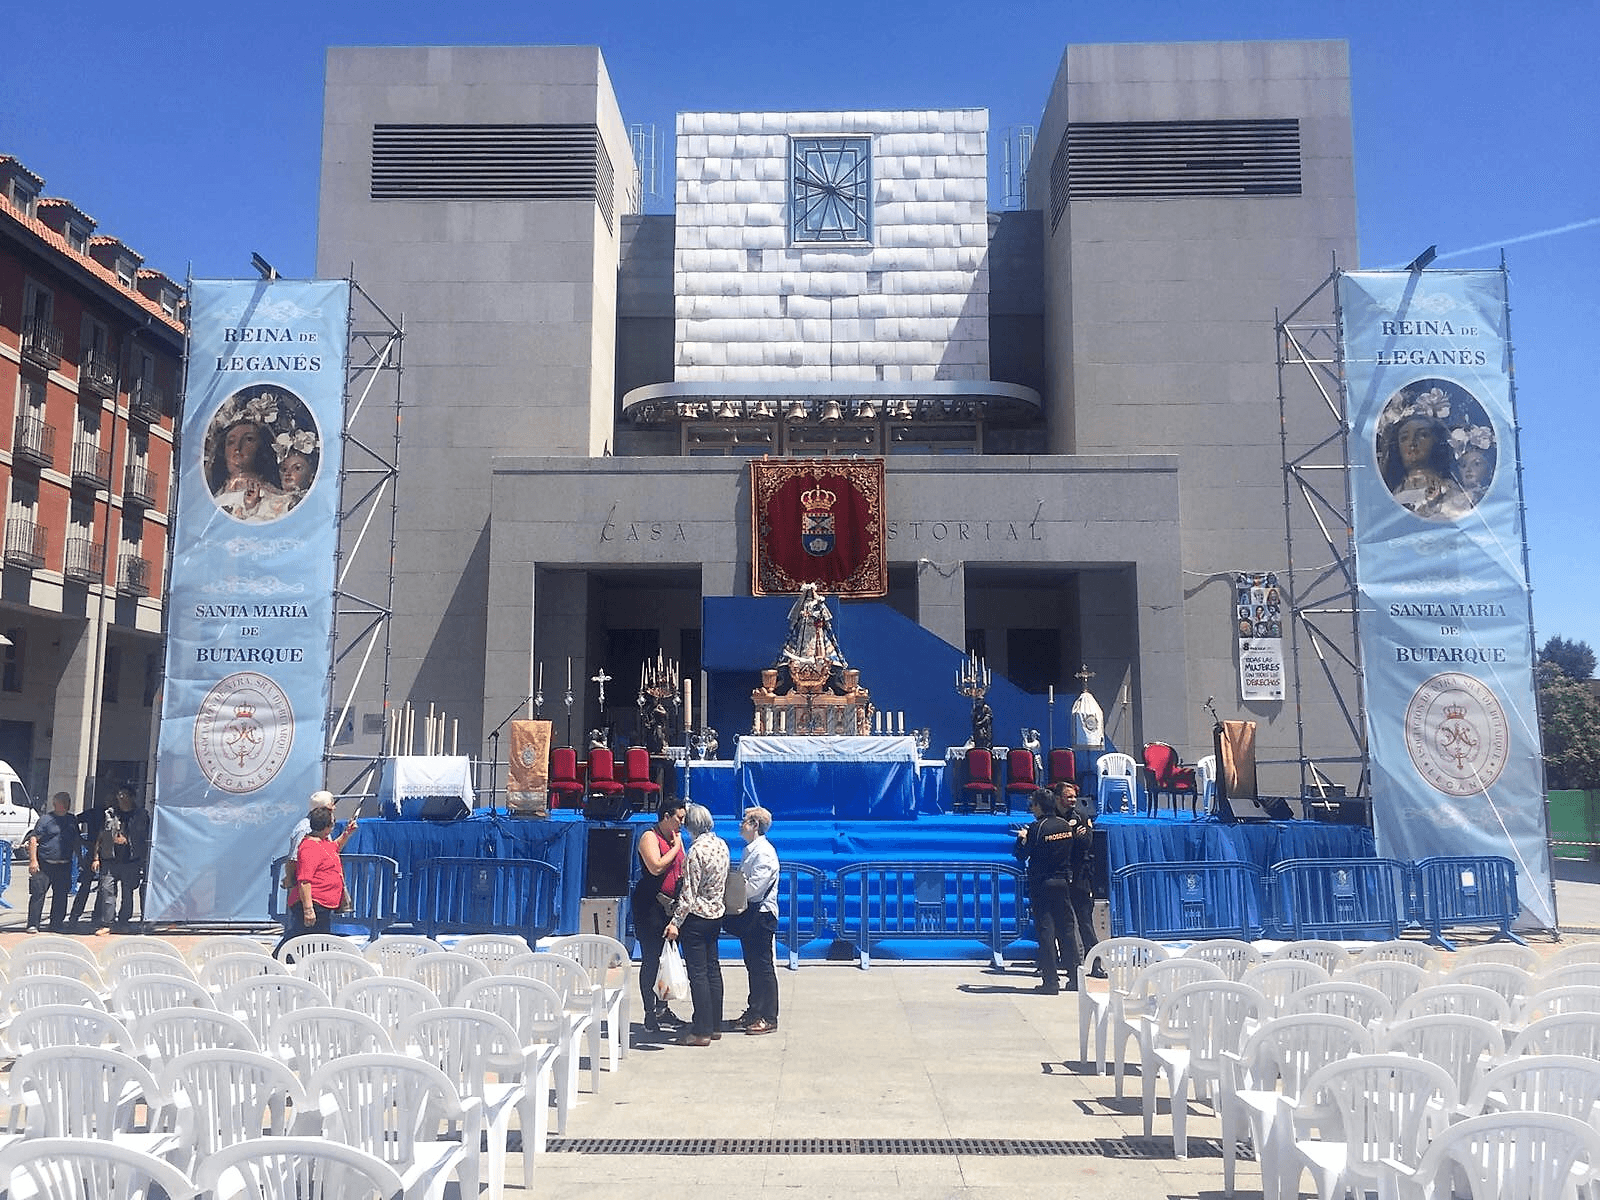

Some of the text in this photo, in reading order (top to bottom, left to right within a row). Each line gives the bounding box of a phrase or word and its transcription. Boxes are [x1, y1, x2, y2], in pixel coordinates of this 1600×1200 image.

[224, 328, 317, 342] REINA DE
[1382, 320, 1478, 336] REINA DE
[216, 352, 321, 371] LEGANÉS
[1377, 347, 1486, 365] LEGANÉS
[600, 521, 687, 542] CASA
[887, 520, 1042, 542] STORIAL
[195, 601, 309, 618] SANTA MARÍA
[1390, 603, 1446, 617] SANTA
[241, 626, 259, 636] DE
[1440, 626, 1458, 635] DE
[196, 648, 303, 664] BUTARQUE
[1396, 647, 1506, 664] BUTARQUE
[1244, 663, 1280, 671] MUJERES
[1245, 678, 1281, 686] DERECHOS
